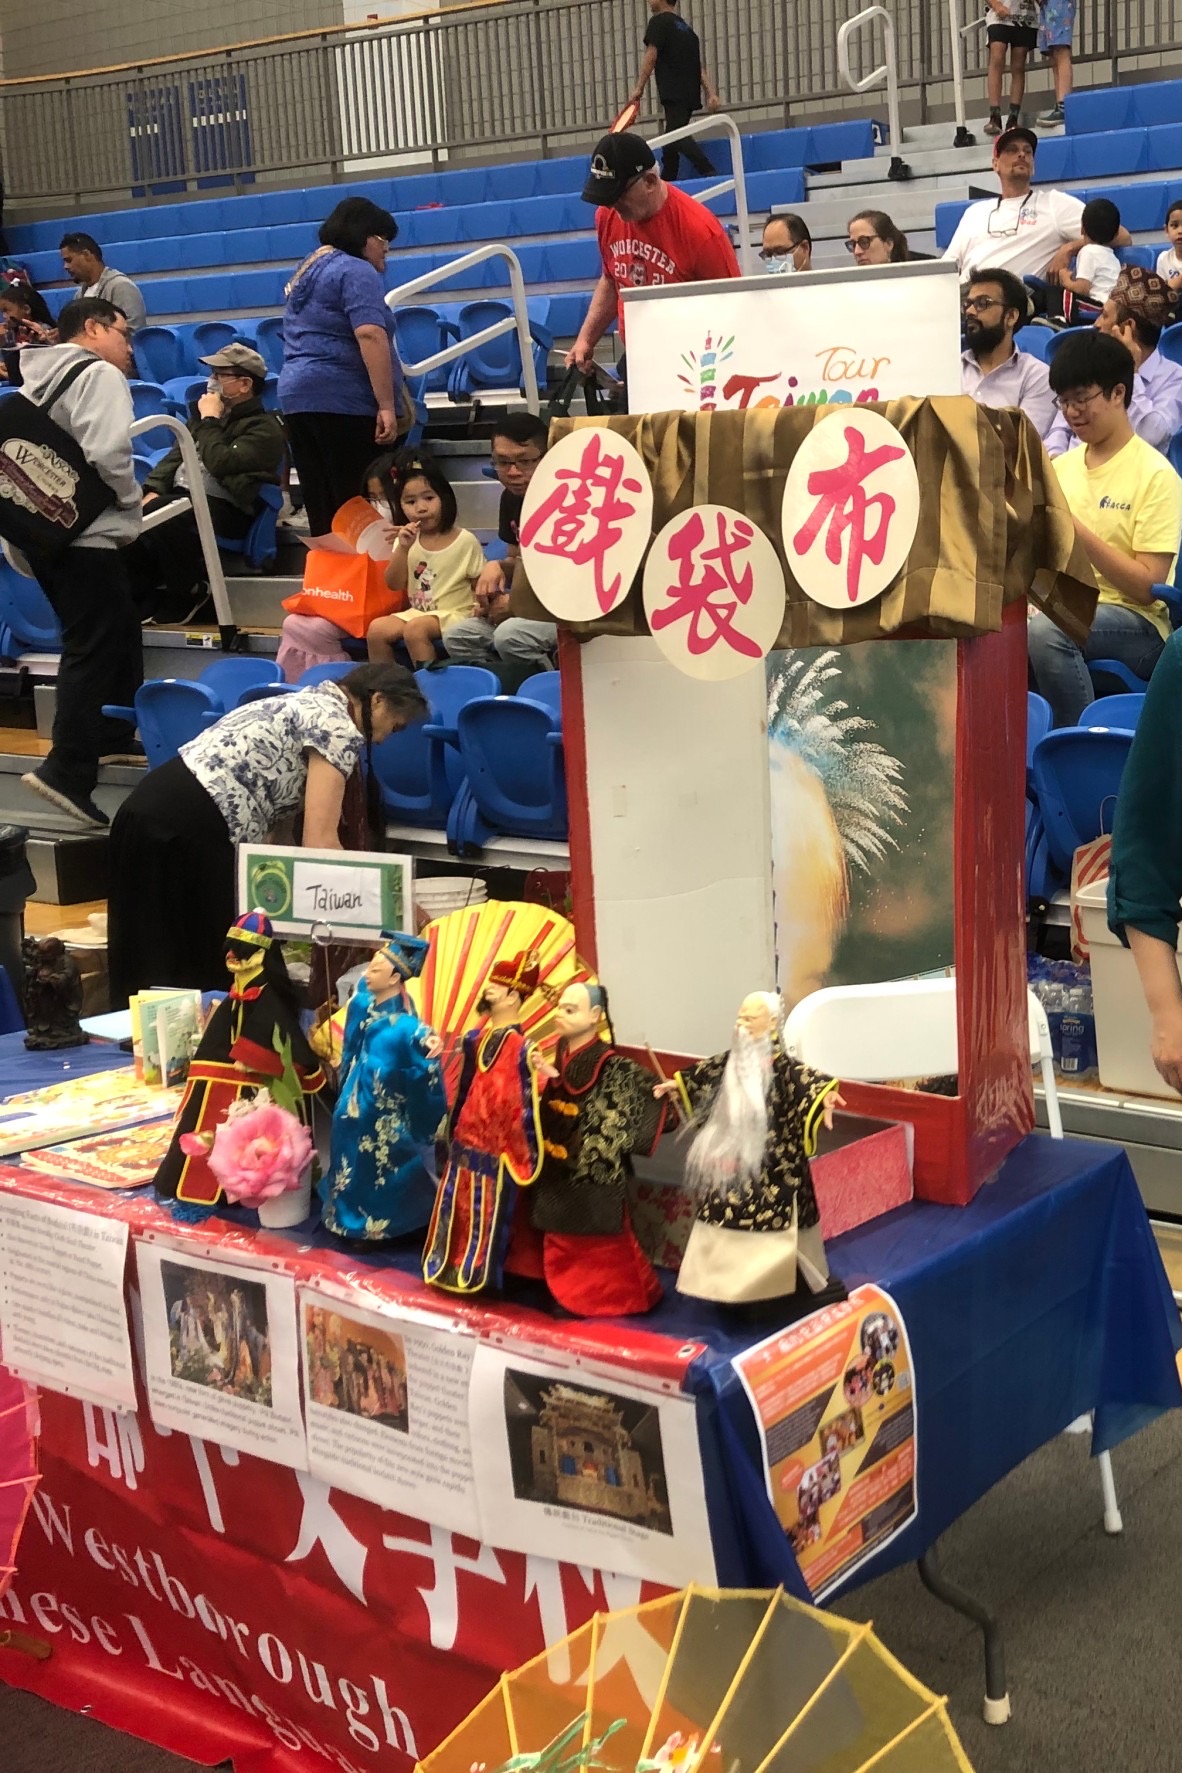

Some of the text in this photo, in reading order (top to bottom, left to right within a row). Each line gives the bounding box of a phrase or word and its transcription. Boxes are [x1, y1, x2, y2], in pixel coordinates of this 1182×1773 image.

[610, 238, 676, 275] WORCESTER
[614, 261, 627, 278] 20
[815, 346, 891, 382] Tour
[793, 425, 906, 602] 布
[306, 884, 363, 911] Taiwan
[34, 1490, 420, 1761] Westborough
